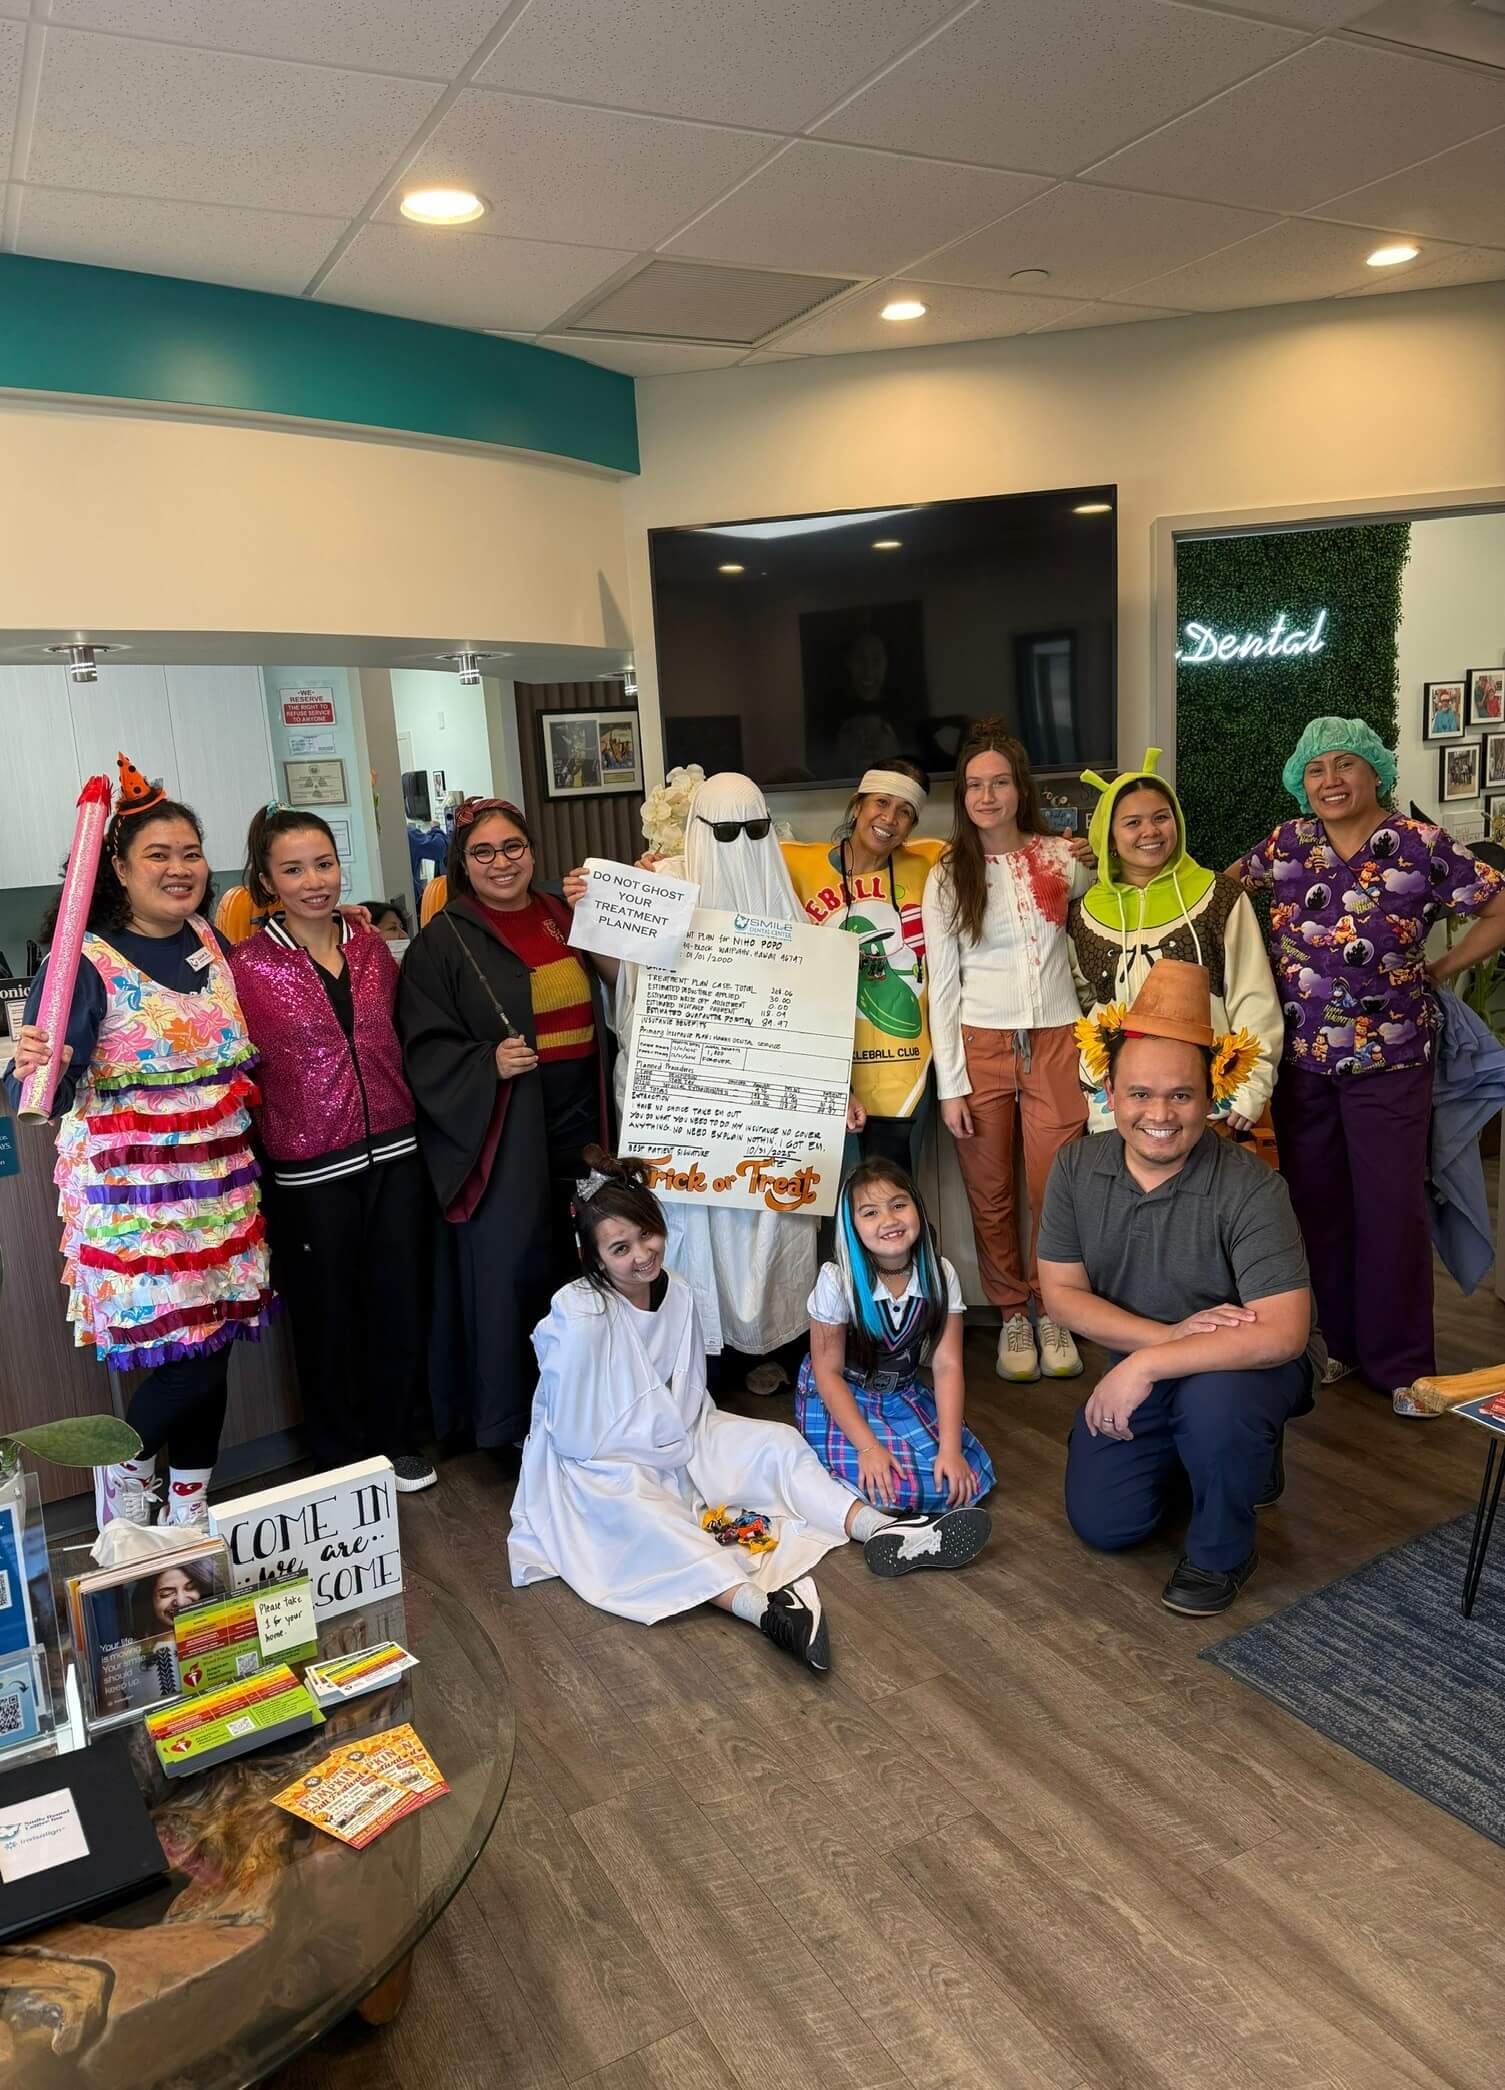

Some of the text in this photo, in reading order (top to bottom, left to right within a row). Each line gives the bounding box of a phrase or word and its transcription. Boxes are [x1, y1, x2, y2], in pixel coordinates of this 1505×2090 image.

[1181, 608, 1327, 662] Dental
[594, 871, 684, 901] DO NOT GHOST
[619, 892, 652, 907] YOUR
[595, 900, 669, 926] TREATMENT
[598, 916, 658, 938] PLANNER
[750, 919, 792, 931] SMILE
[761, 940, 783, 950] POPO
[692, 978, 709, 987] PLAN
[897, 1046, 920, 1057] CLUB
[667, 1105, 689, 1113] CHOICE
[693, 1108, 712, 1116] TAKE
[727, 1110, 742, 1118] OUT
[630, 1111, 643, 1119] YOU
[673, 1115, 688, 1123] YOU
[690, 1116, 708, 1125] NEED
[720, 1120, 730, 1128] DO
[732, 1122, 744, 1130] MY
[782, 1128, 792, 1137] NO
[794, 1129, 822, 1140] COVER
[673, 1126, 683, 1135] NO
[687, 1127, 707, 1137] NEED
[711, 1130, 744, 1141] EXPLAIN
[786, 1140, 805, 1150] GOT
[647, 1146, 675, 1155] PATIENT
[712, 1173, 738, 1193] or
[736, 1156, 821, 1212] Treat
[231, 1481, 390, 1566] COME IN
[259, 1595, 303, 1615] Please take
[285, 1610, 303, 1627] your
[100, 1642, 120, 1653] Your
[102, 1663, 122, 1674] Your
[103, 1669, 133, 1685] should
[104, 1682, 128, 1696] keep
[300, 1768, 357, 1810] PUMPKIN
